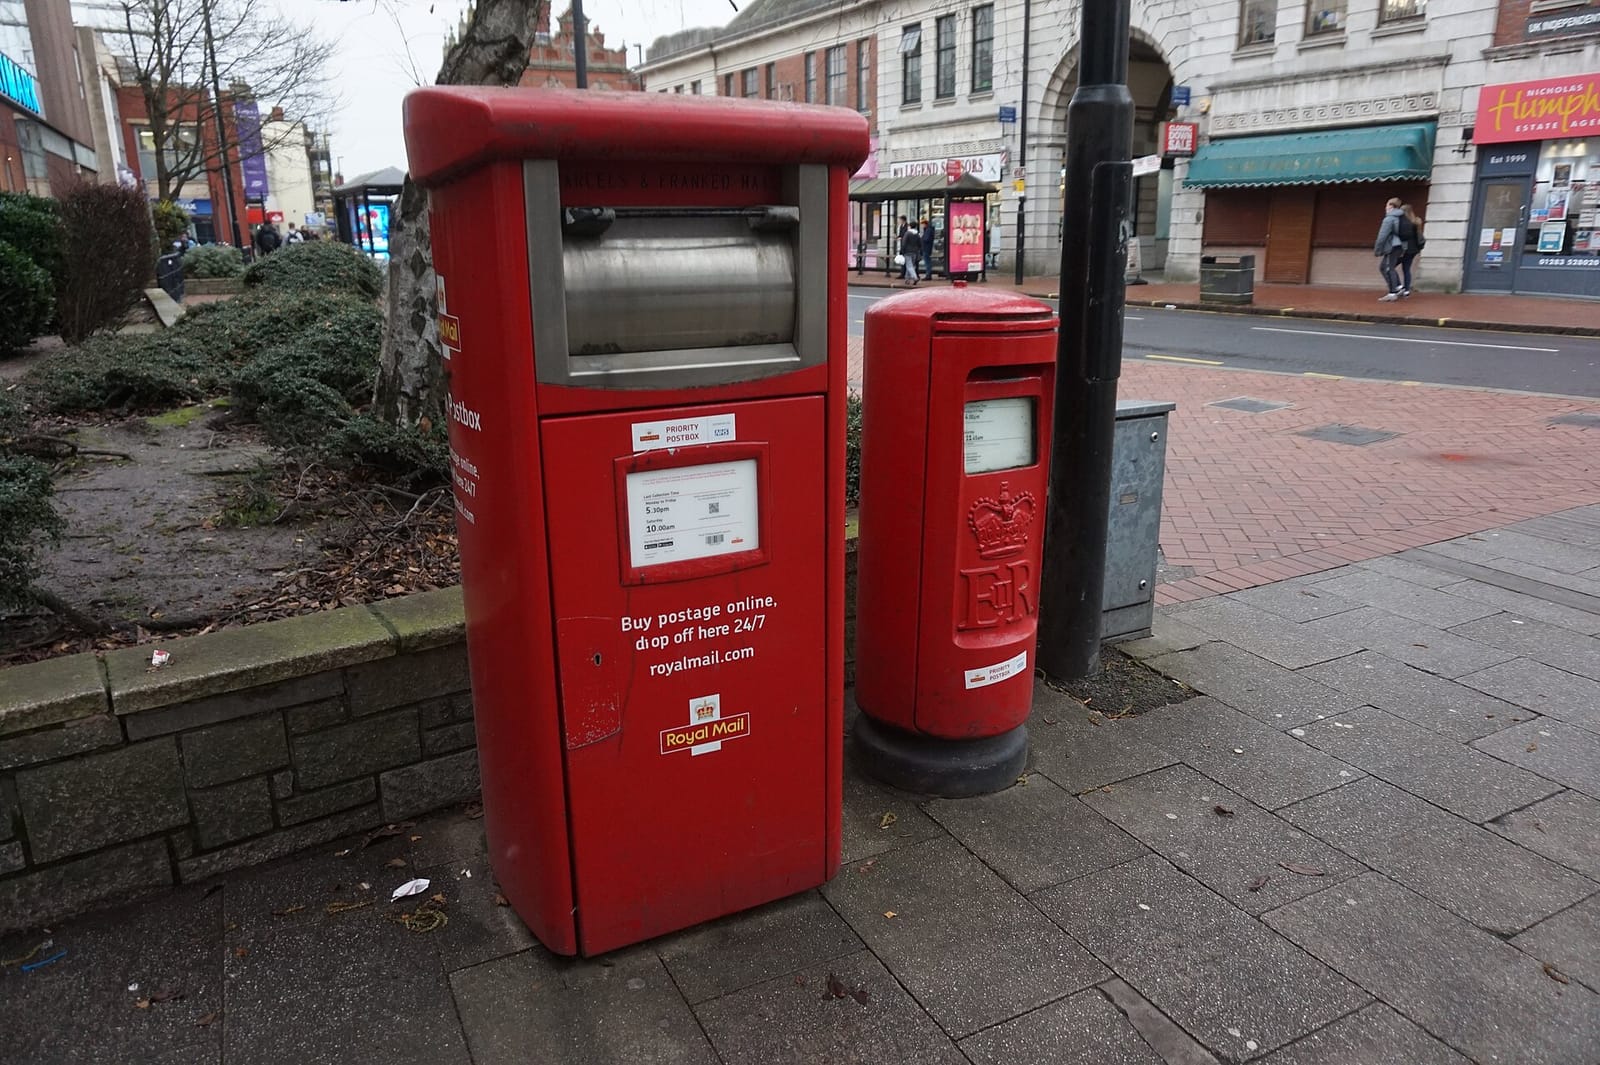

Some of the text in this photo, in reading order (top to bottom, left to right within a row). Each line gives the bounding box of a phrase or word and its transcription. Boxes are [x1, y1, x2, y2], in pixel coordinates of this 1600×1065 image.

[1528, 22, 1542, 33] UK
[1526, 83, 1584, 97] NICHOLAS
[1515, 121, 1558, 132] ESTATE
[1168, 131, 1193, 139] DOWN
[1168, 138, 1193, 152] SALE
[1490, 153, 1527, 164] Est 1999
[905, 162, 938, 177] LEGEND
[640, 174, 649, 188] &
[659, 173, 731, 190] FRANKED
[665, 423, 699, 434] PRIORITY
[666, 433, 700, 443] POSTBOX
[645, 505, 670, 515] 5.30pm
[646, 523, 676, 534] 10.00am
[621, 595, 777, 632] Buy postage online,
[674, 627, 694, 643] off
[698, 624, 730, 640] here
[734, 614, 765, 633] 24/7
[650, 646, 755, 677] royalmail.com
[989, 663, 1010, 675] PRIORITY
[989, 670, 1010, 681] POSTBOX
[666, 717, 744, 747] Royal Mail
